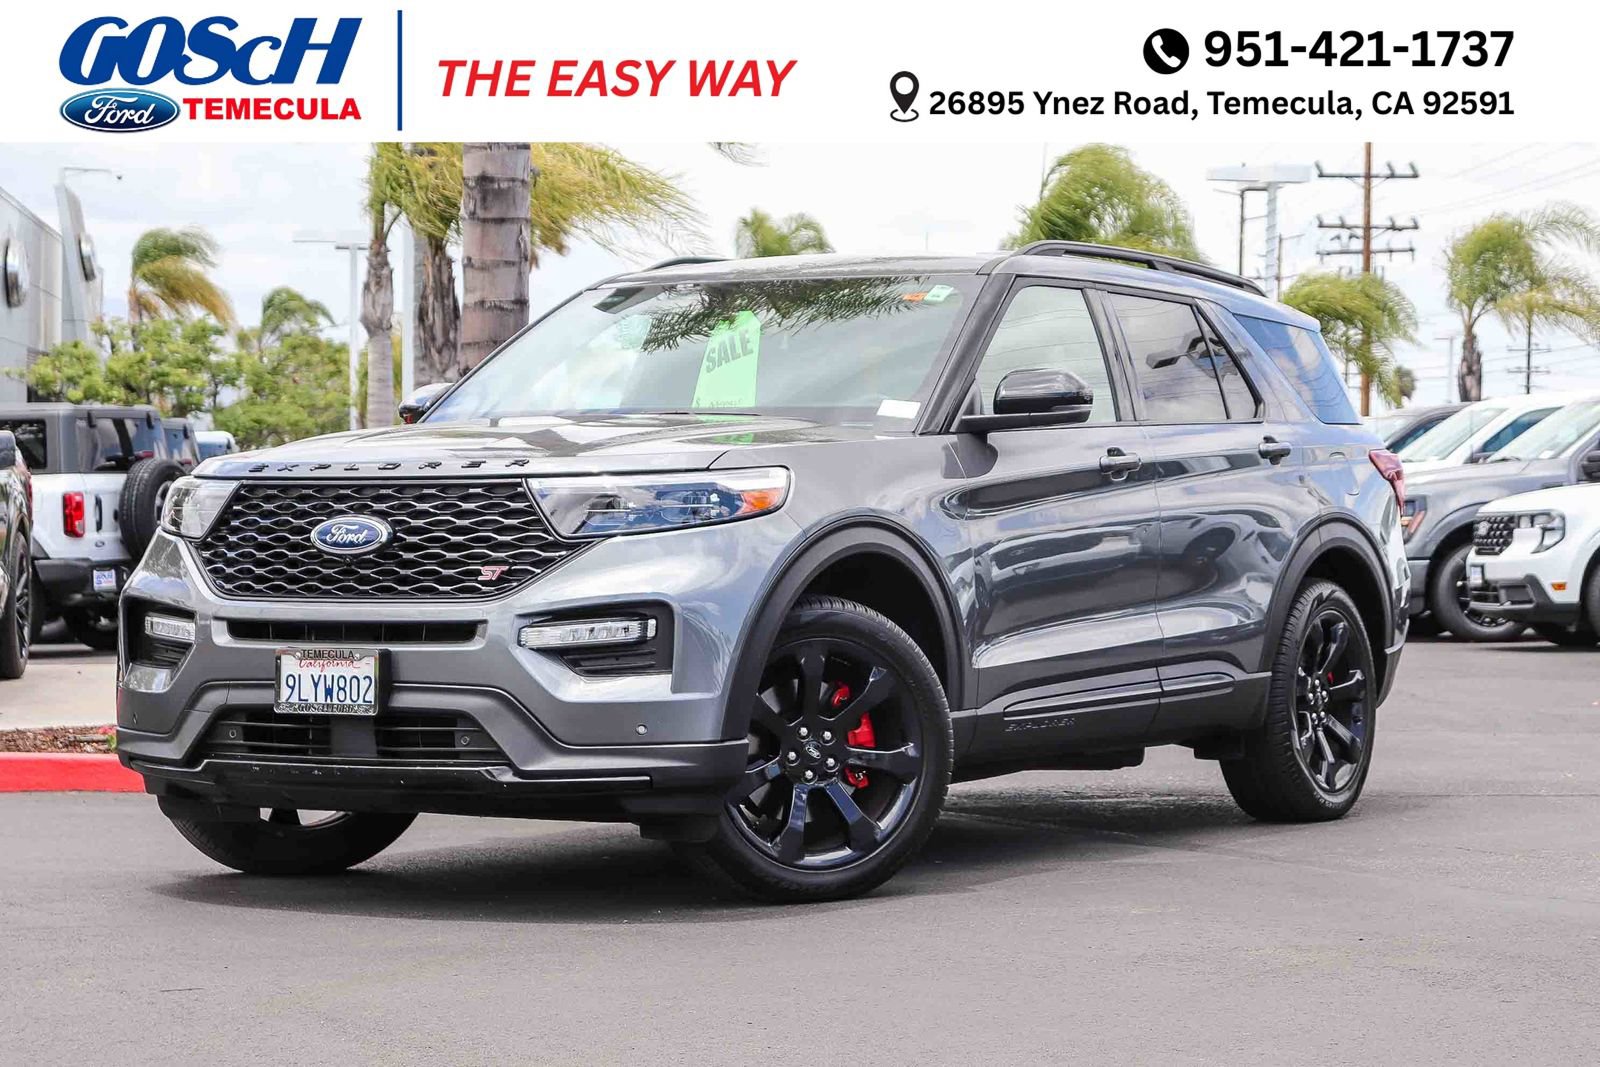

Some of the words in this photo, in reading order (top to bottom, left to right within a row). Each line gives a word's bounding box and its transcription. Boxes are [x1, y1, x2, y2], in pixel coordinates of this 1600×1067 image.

[705, 328, 754, 374] SALE
[248, 458, 530, 473] EXPLORER
[326, 523, 369, 545] Ford
[477, 565, 509, 581] ST
[300, 649, 355, 660] TEMECULA
[298, 658, 361, 673] California
[285, 673, 373, 704] 9LYW802
